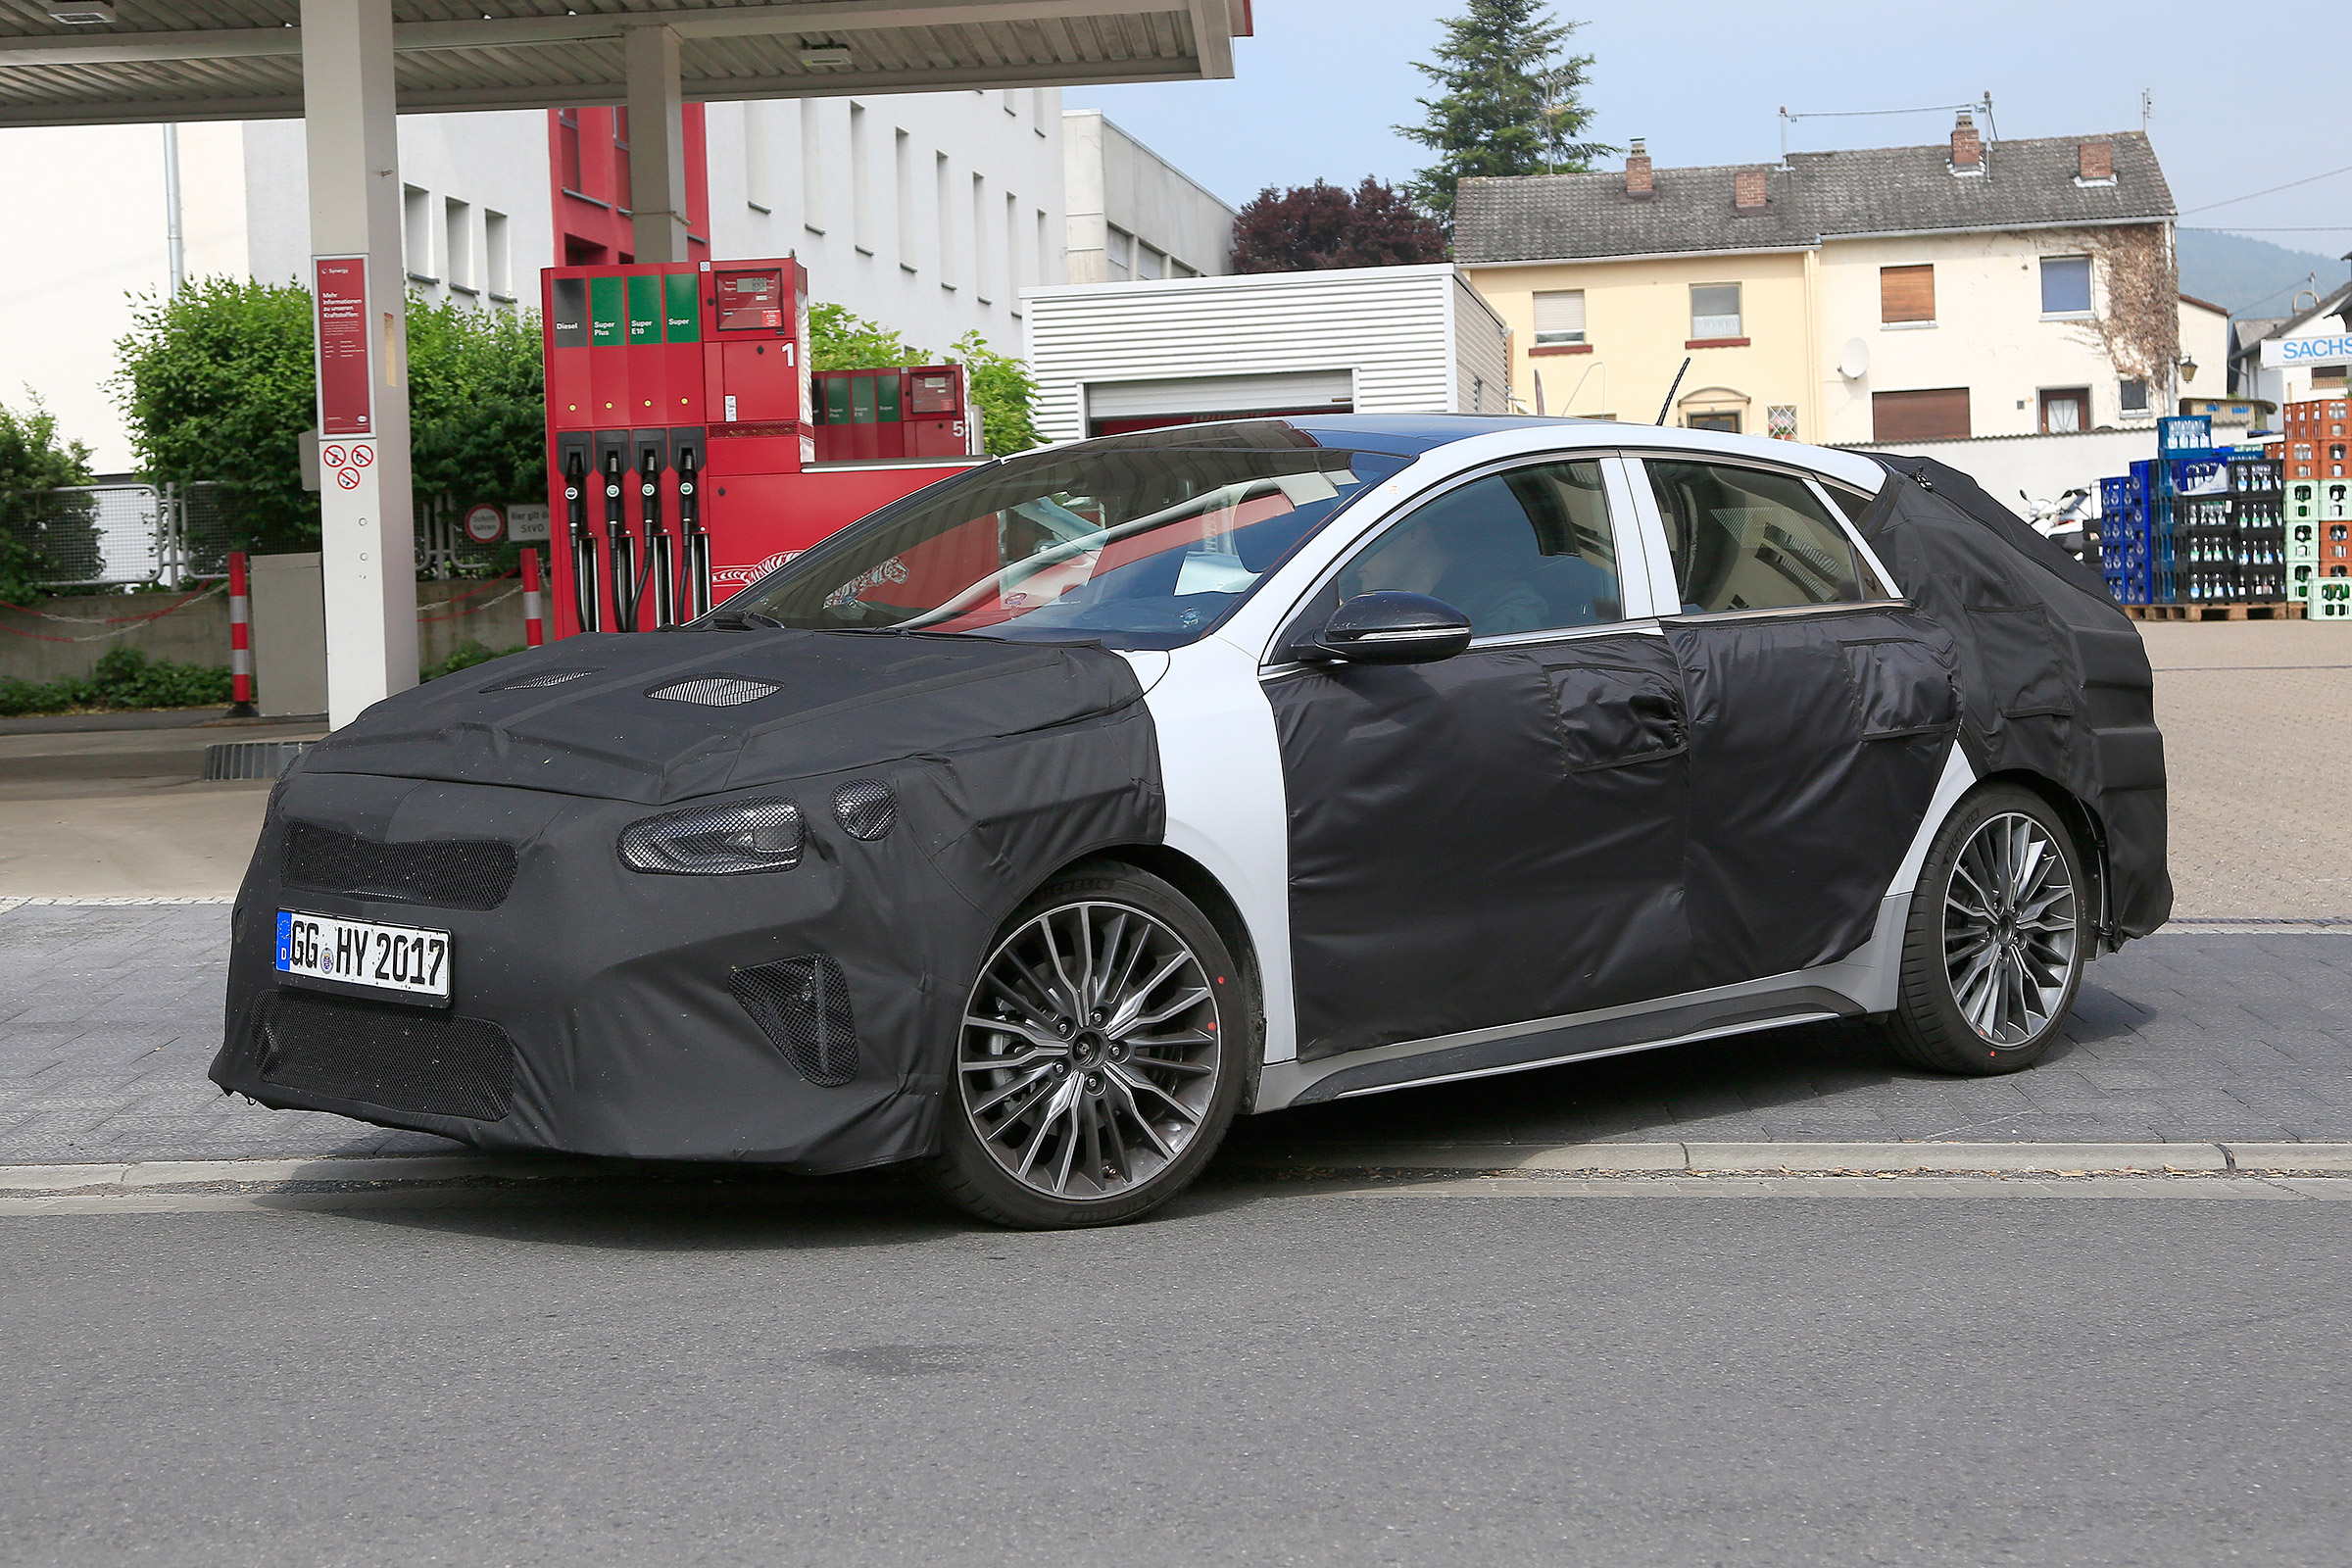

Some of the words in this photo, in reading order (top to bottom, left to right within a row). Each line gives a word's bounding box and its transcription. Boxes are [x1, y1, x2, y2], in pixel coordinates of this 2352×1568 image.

[781, 343, 795, 368] 1
[2283, 337, 2352, 360] SACHS
[953, 420, 964, 437] 5
[520, 523, 545, 533] StVO
[281, 948, 287, 961] D
[293, 920, 319, 969] GG
[336, 926, 368, 977] HY
[375, 933, 445, 986] 2017
